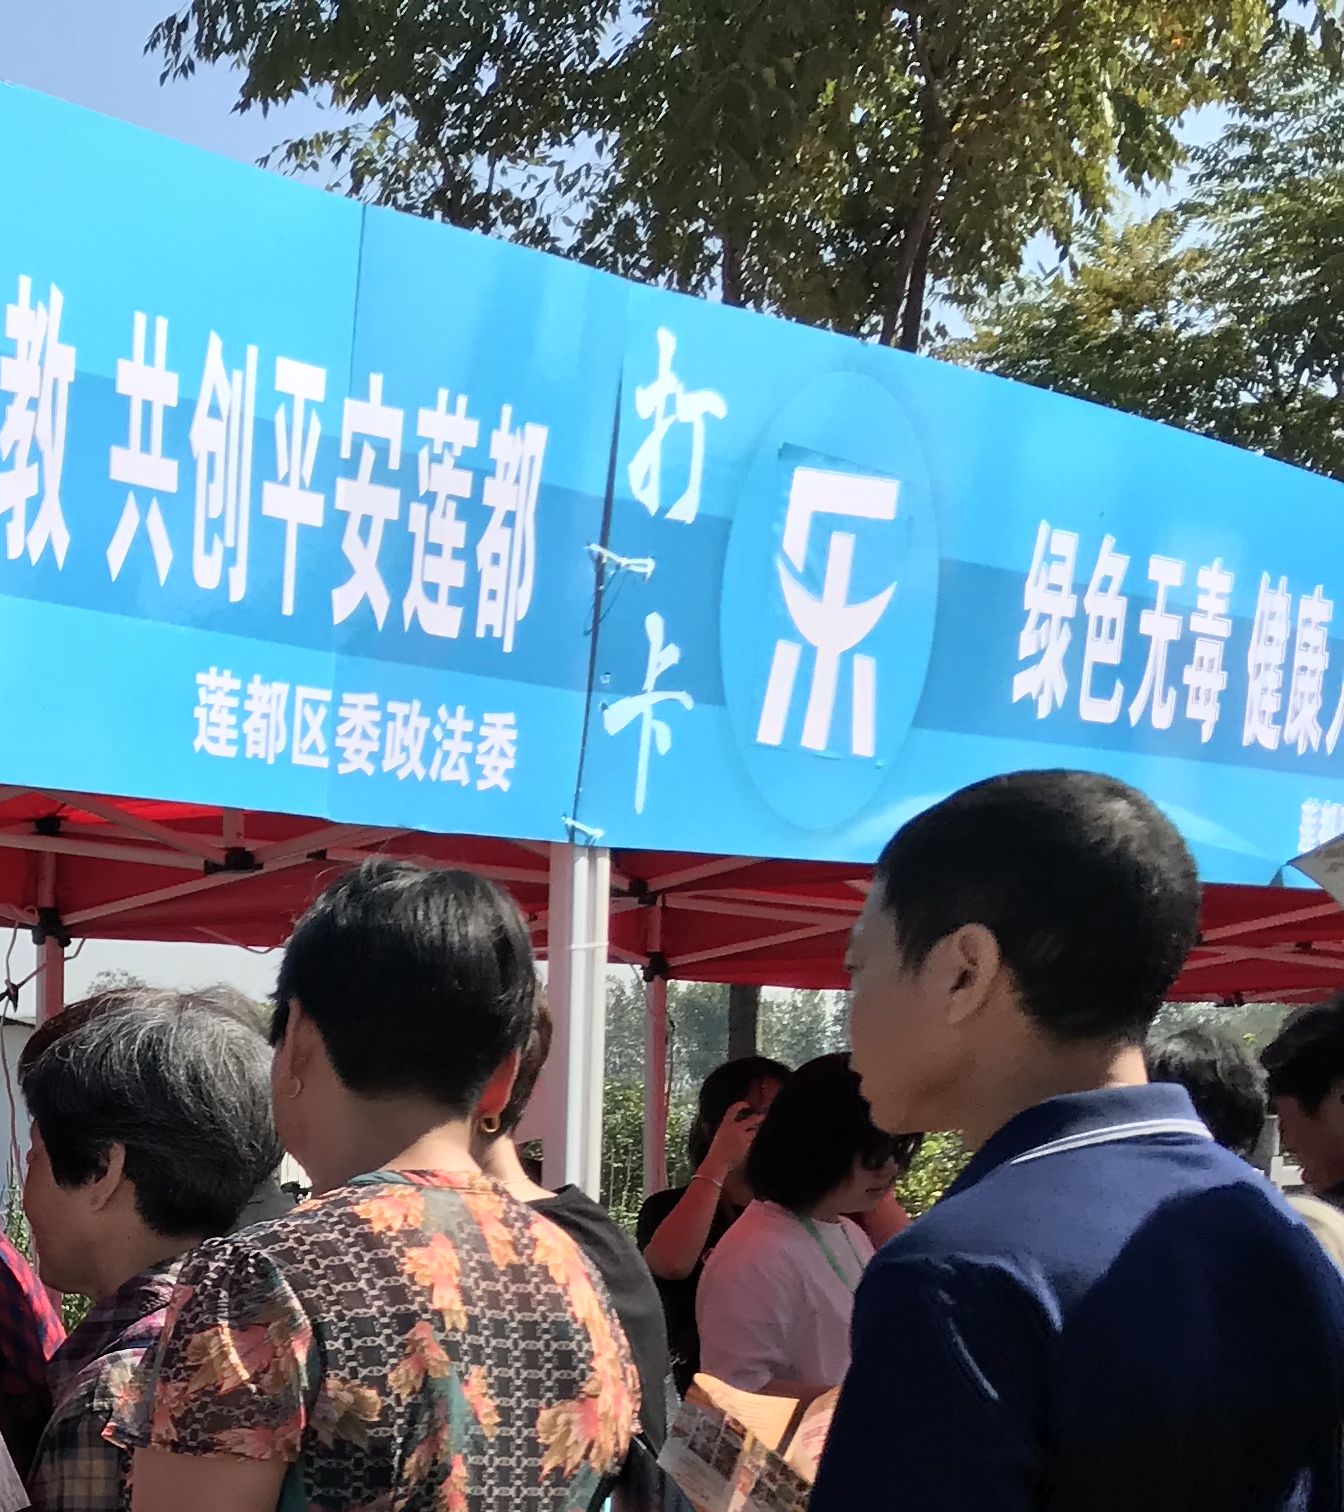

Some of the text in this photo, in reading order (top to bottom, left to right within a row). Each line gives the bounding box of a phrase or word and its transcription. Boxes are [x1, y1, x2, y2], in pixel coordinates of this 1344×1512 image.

[106, 311, 548, 652] 共创平安莲都
[193, 667, 518, 792] 莲都区委政法委
[1013, 520, 1235, 743] 绿色无毒
